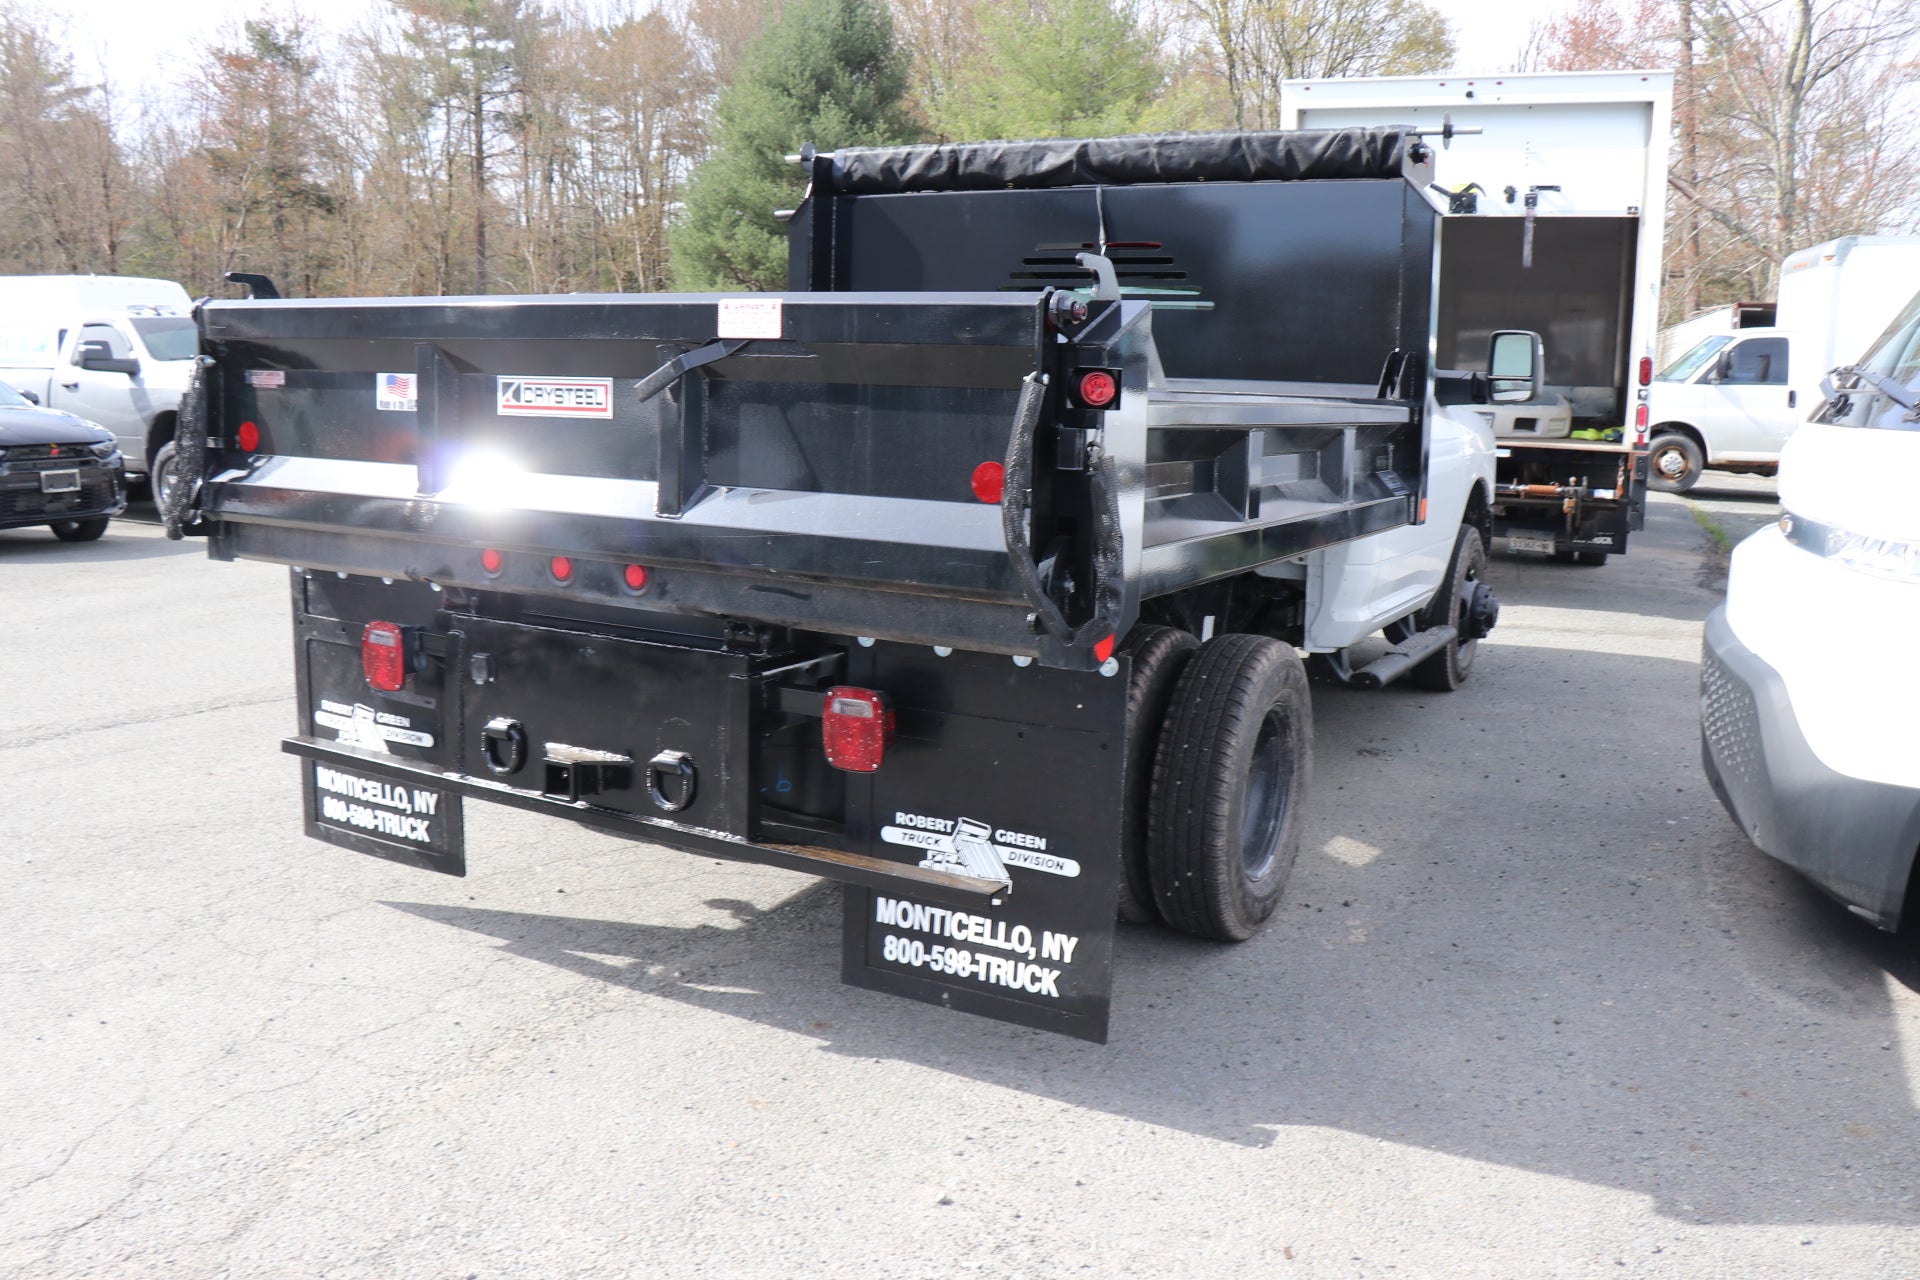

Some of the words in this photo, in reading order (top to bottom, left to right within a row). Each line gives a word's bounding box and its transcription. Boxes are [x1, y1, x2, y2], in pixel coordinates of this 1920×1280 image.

[524, 387, 603, 405] CRYSTEEL
[376, 712, 411, 728] GREEN
[386, 729, 424, 743] DIVISION
[317, 766, 412, 815] MONTICELLO,
[414, 790, 439, 815] NY
[895, 811, 955, 833] ROBERT
[995, 829, 1047, 850] GREEN
[901, 831, 942, 847] TRUCK
[1007, 851, 1065, 871] DIVISION
[876, 897, 1036, 961] MONTICELLO,
[1042, 930, 1078, 964] NY
[883, 934, 1061, 998] 800-598-TRUCK
